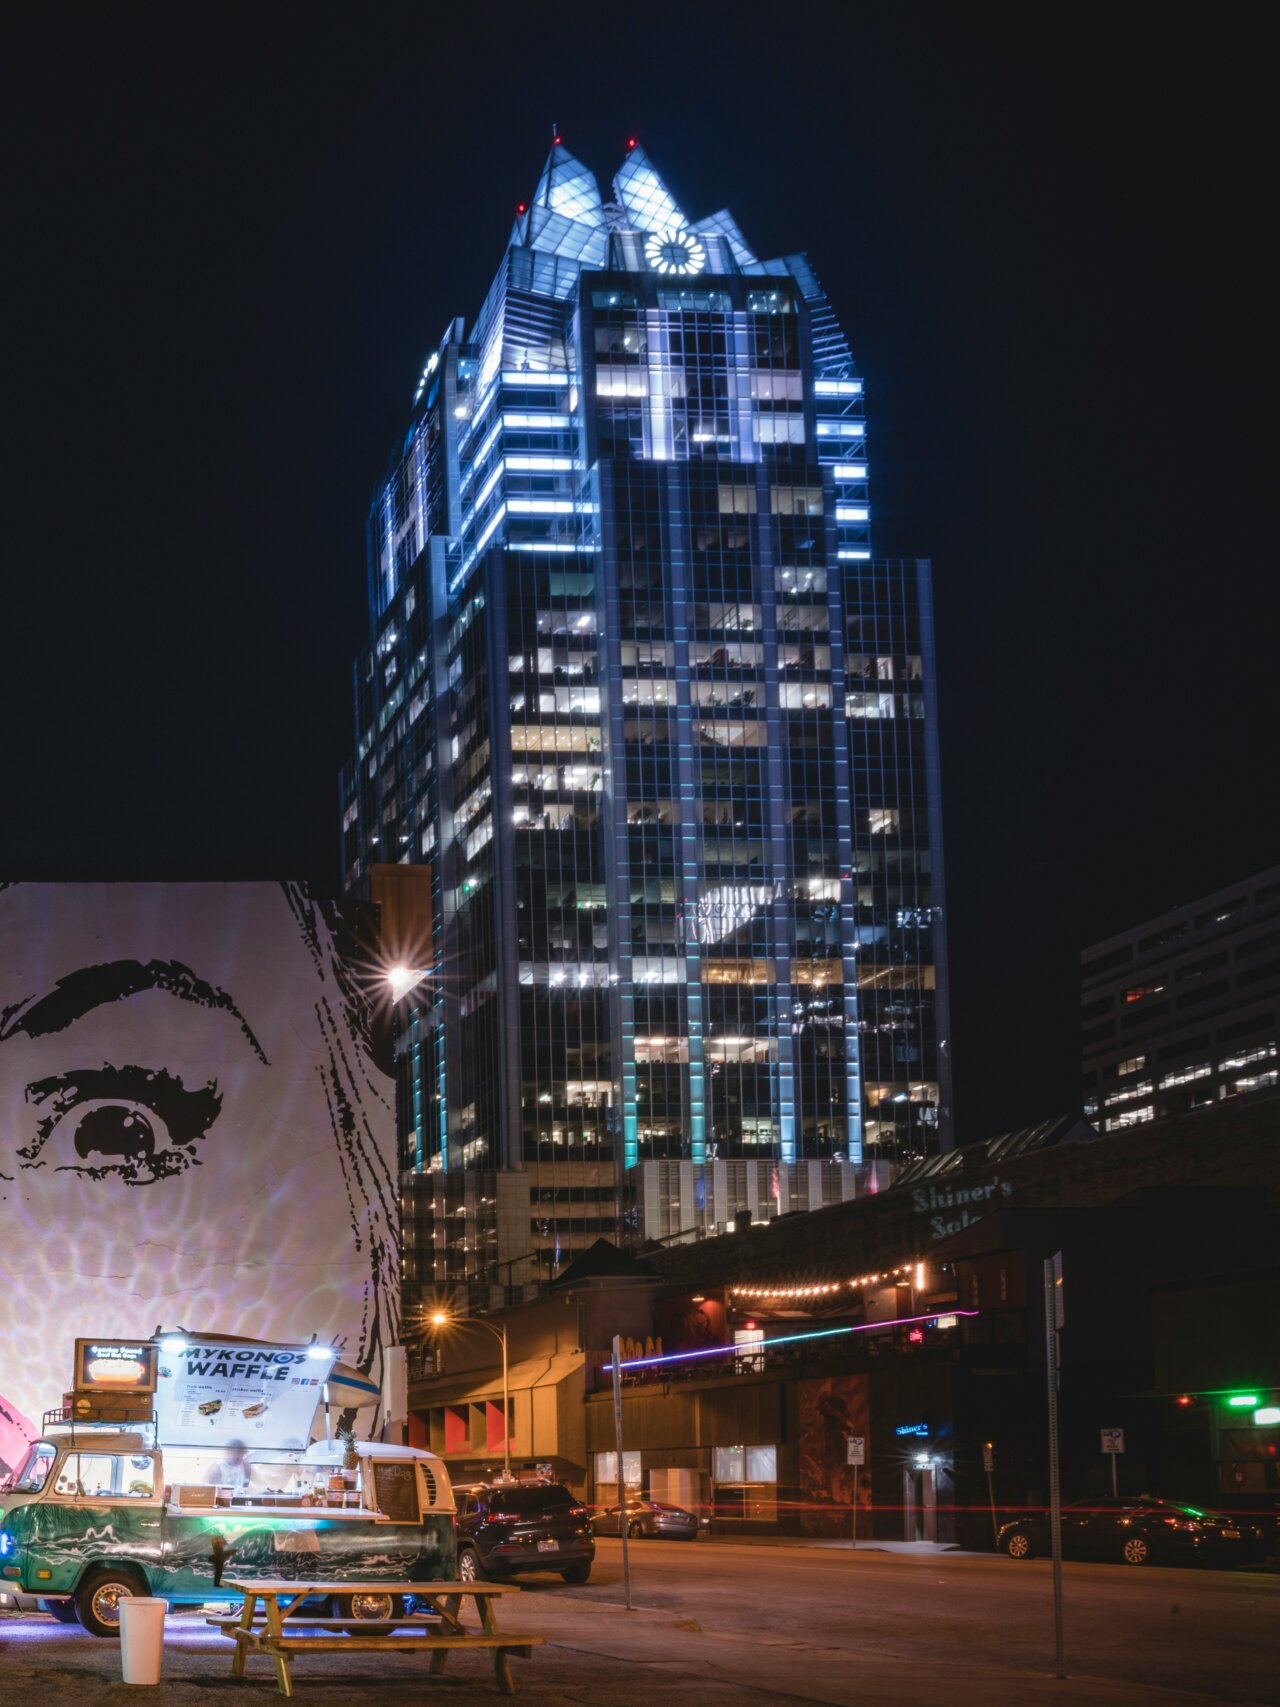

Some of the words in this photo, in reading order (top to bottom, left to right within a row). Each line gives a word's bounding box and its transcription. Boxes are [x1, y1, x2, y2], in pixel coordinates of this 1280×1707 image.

[911, 1176, 1013, 1213] Shiner's
[178, 1347, 308, 1365] MYKONOS
[187, 1361, 290, 1381] WAFFLE
[896, 1423, 928, 1435] Shiner's
